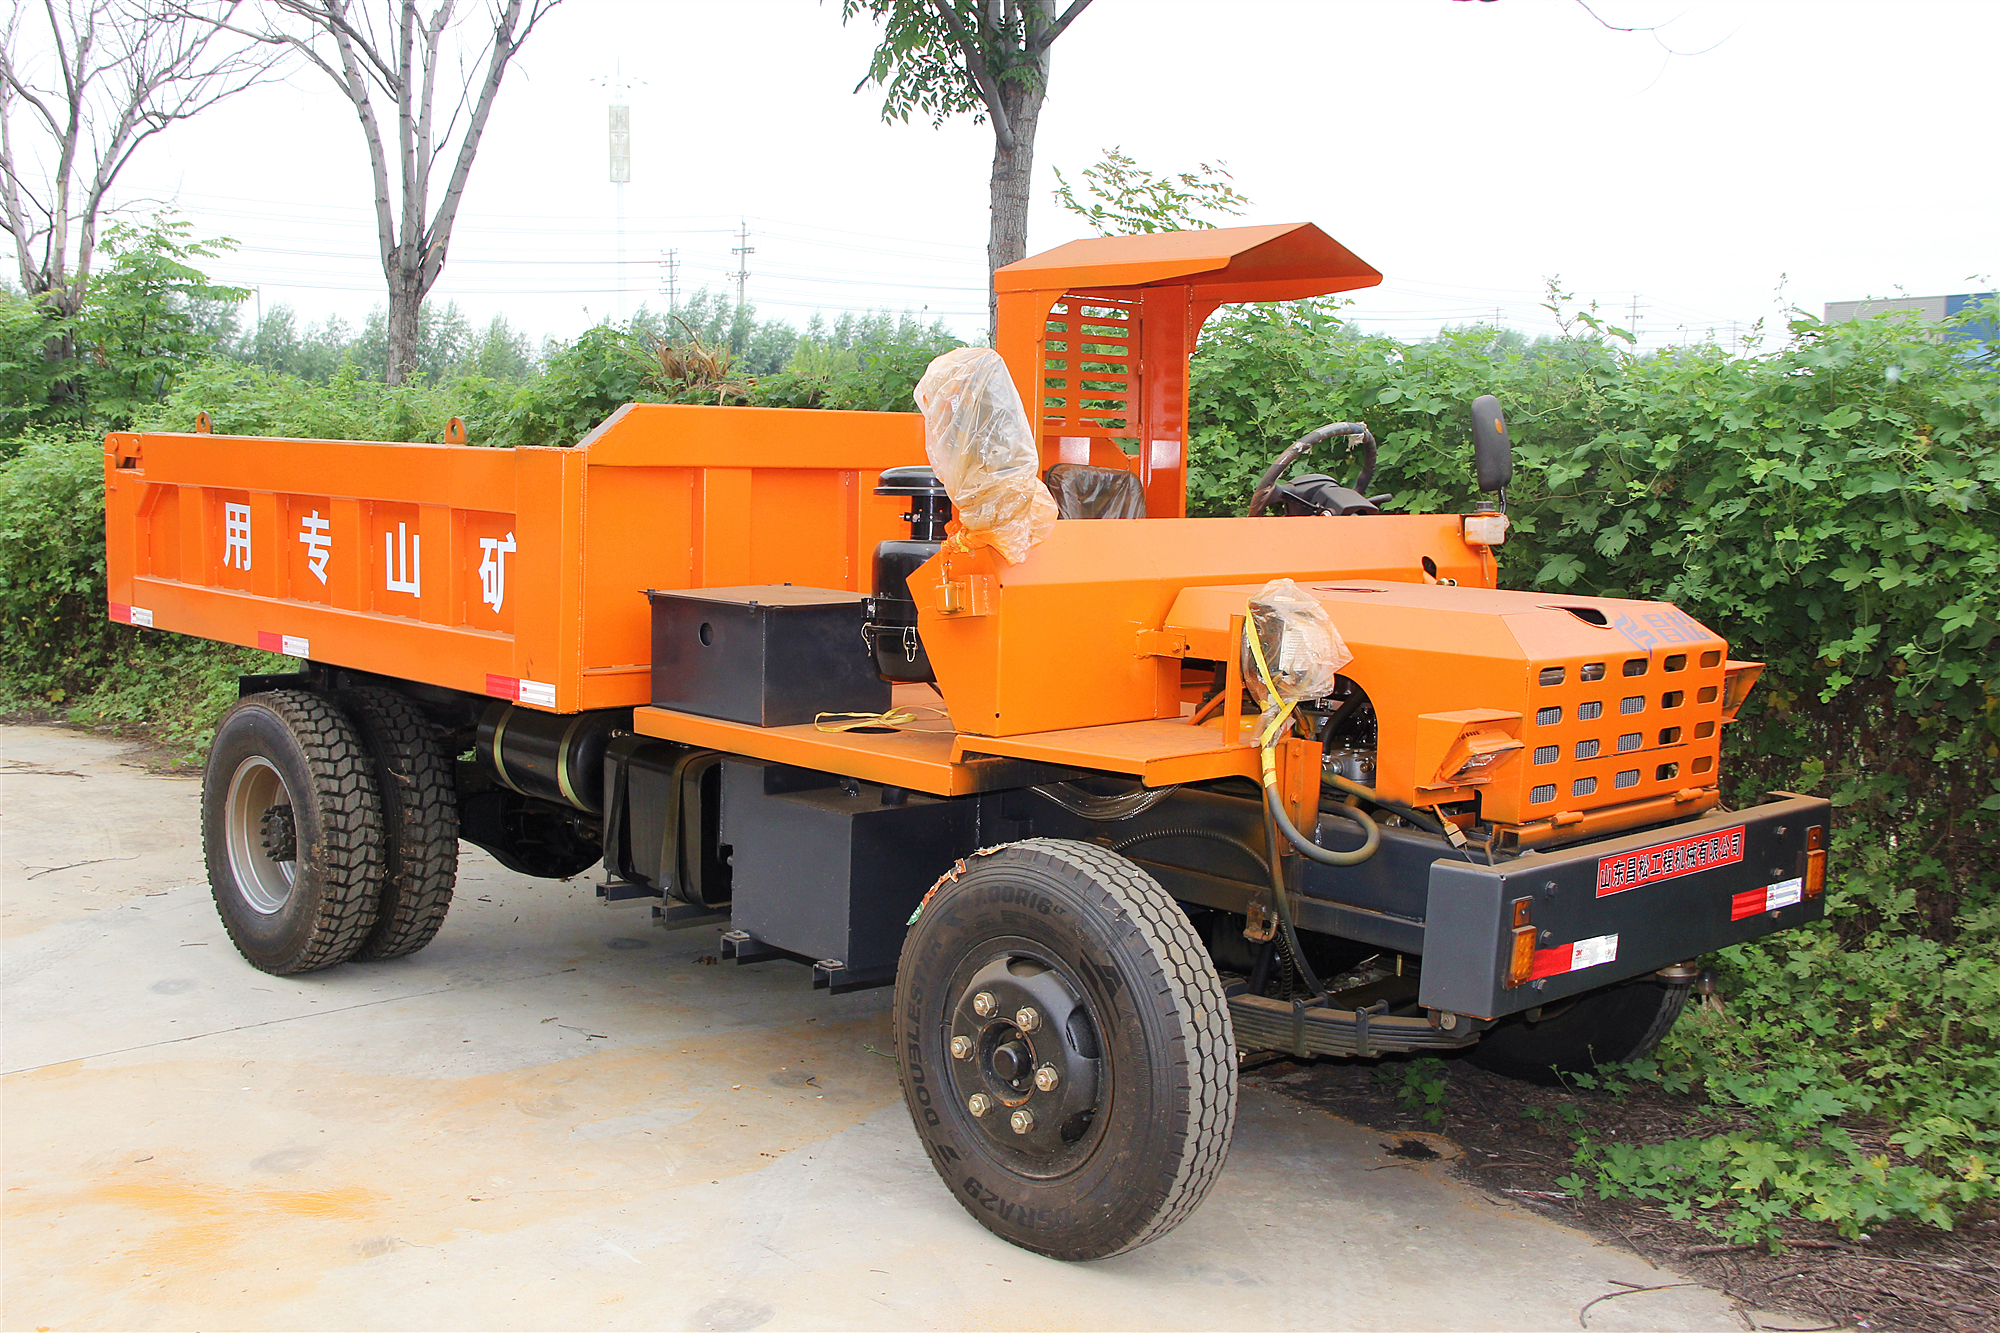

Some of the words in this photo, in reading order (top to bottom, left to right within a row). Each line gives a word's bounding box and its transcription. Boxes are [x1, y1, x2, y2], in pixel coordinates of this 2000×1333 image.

[1642, 611, 1712, 643] 昌松
[1599, 832, 1742, 890] 山东昌松工程机械有限公司
[907, 933, 943, 1127] DOUBLESTAR
